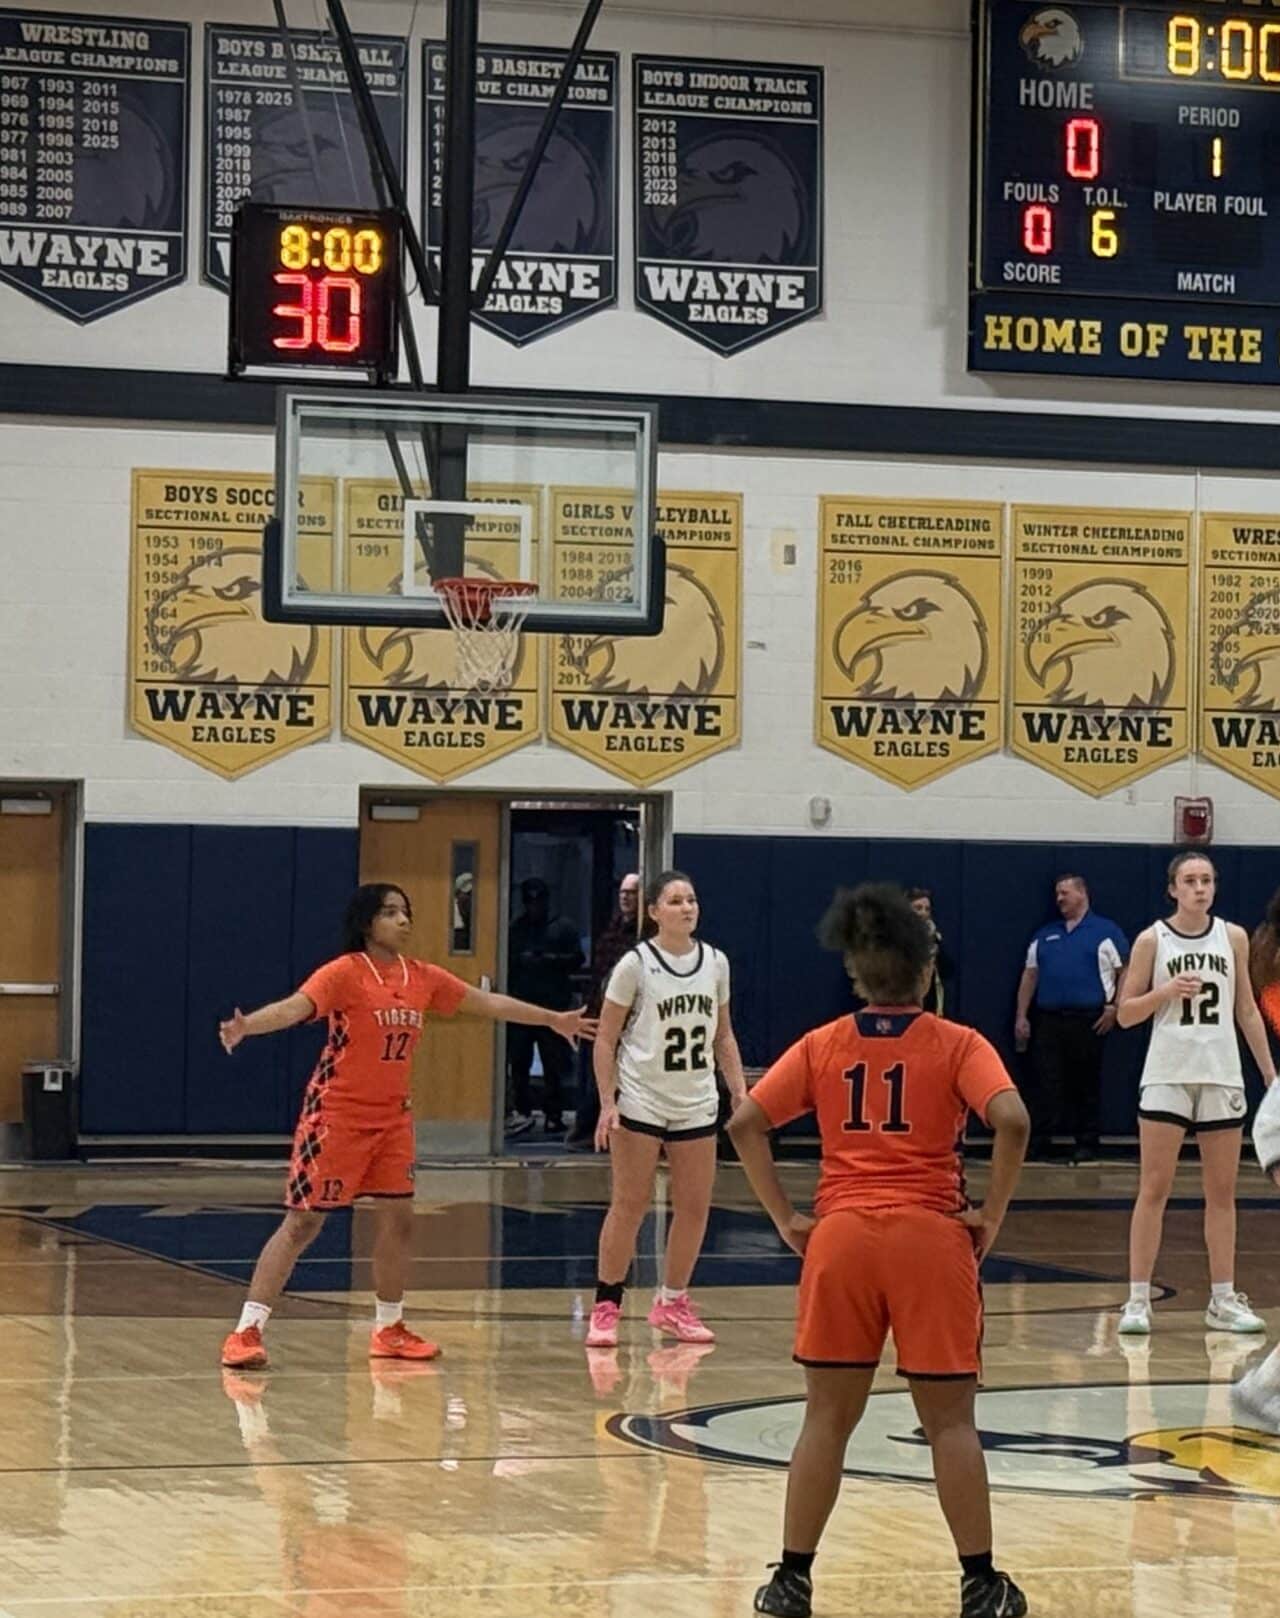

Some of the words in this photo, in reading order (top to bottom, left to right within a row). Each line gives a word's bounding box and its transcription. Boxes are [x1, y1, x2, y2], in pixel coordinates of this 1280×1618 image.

[21, 23, 149, 50] WRESTLING
[217, 38, 265, 58] BOYS
[71, 52, 178, 72] CHAMPIONS
[217, 62, 286, 79] LEAGUE
[82, 82, 117, 96] 2011
[643, 70, 684, 87] BOYS
[690, 73, 749, 92] INDOOR
[754, 77, 808, 95] TRACK
[256, 91, 293, 106] 2025
[644, 92, 709, 108] LEAGUE
[714, 96, 812, 114] CHAMPIONS
[1019, 78, 1094, 109] HOME
[82, 100, 119, 114] 2015
[1178, 106, 1240, 128] PERIOD
[642, 119, 677, 133] 2012
[82, 135, 119, 148] 2025
[1066, 118, 1099, 179] 0
[1212, 137, 1222, 178] 1
[1003, 182, 1059, 203] FOULS
[1083, 187, 1128, 207] T.O.L.
[36, 204, 73, 218] 2007
[1154, 191, 1217, 213] PLAYER
[1224, 196, 1267, 216] FOUL
[1024, 205, 1052, 254] 0
[1091, 210, 1118, 257] 6
[0, 230, 168, 276] WAYNE
[281, 225, 382, 274] 8:00
[41, 268, 129, 291] EAGLES
[1003, 262, 1061, 283] SCORE
[1177, 272, 1236, 294] MATCH
[644, 267, 805, 309] WAYNE
[273, 274, 361, 352] 30
[483, 293, 562, 314] EAGLES
[688, 304, 768, 325] EAGLES
[984, 315, 1101, 355] HOME
[1120, 322, 1168, 358] OF
[1184, 325, 1262, 364] THE
[164, 485, 218, 504] BOYS
[145, 508, 231, 523] SECTIONAL
[562, 504, 614, 520] GIRLS
[836, 514, 873, 528] FALL
[878, 515, 991, 532] CHEERLEADING
[1023, 523, 1078, 538] WINTER
[1083, 526, 1184, 542] CHEERLEADING
[145, 535, 179, 549] 1953
[831, 534, 909, 547] SECTIONAL
[913, 537, 995, 550] CHAMPIONS
[1022, 542, 1098, 556] SECTIONAL
[1102, 546, 1183, 558] CHAMPIONS
[145, 554, 179, 567] 1954
[829, 559, 863, 572] 2016
[145, 688, 314, 727] WAYNE
[358, 695, 523, 731] WAYNE
[561, 699, 721, 736] WAYNE
[830, 706, 985, 741] WAYNE
[1022, 712, 1173, 747] WAYNE
[192, 726, 275, 744] EAGLES
[404, 731, 485, 748] EAGLES
[605, 735, 685, 752] EAGLES
[874, 740, 950, 758] EAGLES
[1063, 747, 1138, 764] EAGLES
[1166, 952, 1229, 978] WAYNE
[657, 994, 713, 1021] WAYNE
[1179, 982, 1220, 1026] 12
[381, 1031, 411, 1061] 12
[664, 1025, 708, 1072] 22
[841, 1061, 912, 1134] 11
[320, 1179, 343, 1201] 12
